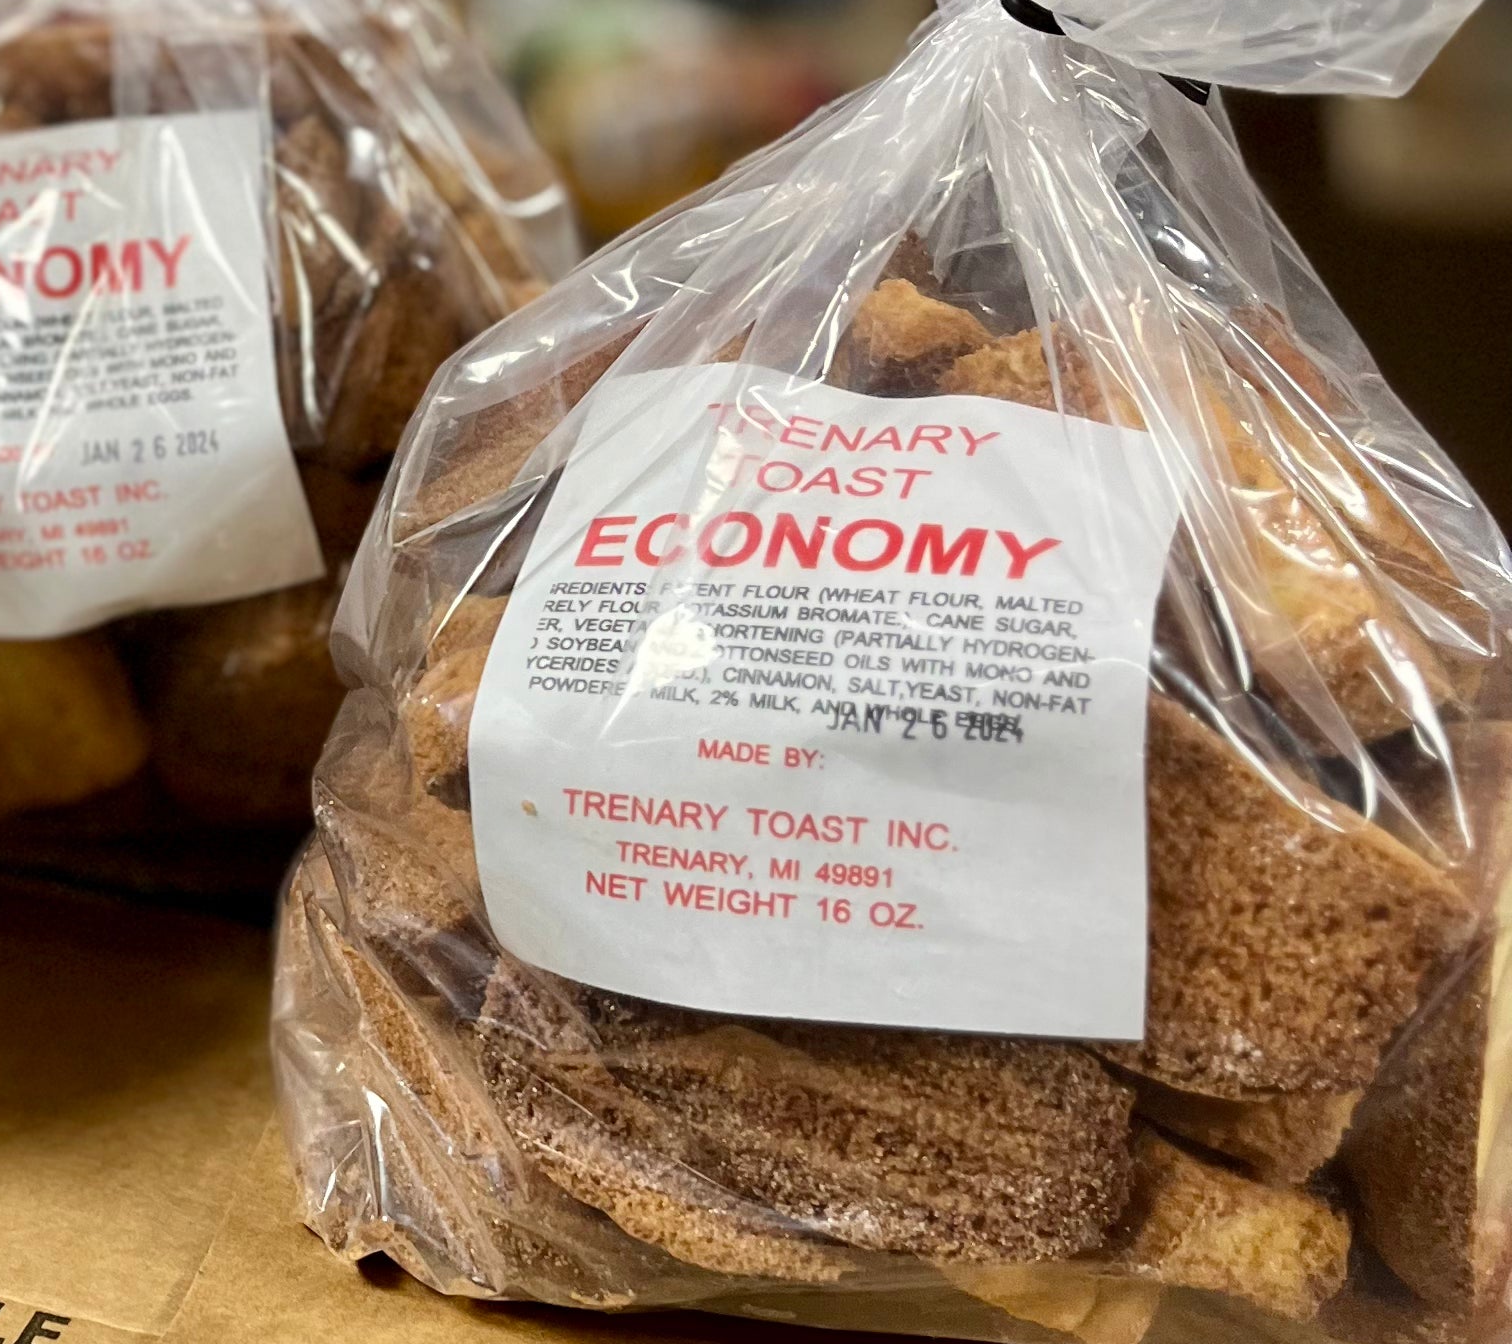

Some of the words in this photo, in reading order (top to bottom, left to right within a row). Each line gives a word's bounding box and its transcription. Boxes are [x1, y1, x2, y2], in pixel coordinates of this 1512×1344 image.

[171, 364, 239, 383] NON-FAT
[204, 348, 238, 362] AND
[81, 439, 121, 466] JAN
[175, 430, 220, 457] 2024
[707, 403, 1000, 457] TRENARY
[20, 485, 101, 513] TOAST
[115, 480, 167, 504] INC.
[725, 453, 932, 500] TOAST
[573, 512, 1063, 580] ECONOMY
[543, 600, 592, 613] RELY
[598, 600, 660, 614] FLOUR
[691, 602, 788, 620] OTASSIUM
[926, 612, 985, 630] CANE
[995, 617, 1077, 640] SUGAR,
[742, 584, 809, 601] FLOUR
[818, 586, 900, 605] (WHEAT
[909, 591, 984, 610] FLOUR,
[995, 596, 1083, 615] MALTED
[546, 636, 636, 653] SOYBEAN
[710, 644, 834, 667] OTTONSEED
[844, 653, 891, 672] OILS
[902, 657, 954, 677] WITH
[966, 661, 1032, 684] MONO
[1043, 670, 1091, 690] AND
[574, 618, 648, 633] VEGETA
[700, 623, 824, 645] HORTENING
[834, 629, 954, 654] (PARTIALLY
[962, 638, 1095, 664] HYDROGEN-
[527, 655, 620, 673] YCERIDES
[722, 667, 836, 694] CINNAMON,
[992, 689, 1092, 715] NON-FAT
[528, 676, 628, 697] POWDERE
[649, 686, 700, 704] MILK,
[710, 689, 739, 707] 2%
[750, 692, 801, 713] MILK,
[697, 738, 770, 765] MADE
[783, 747, 825, 770] BY:
[562, 788, 729, 832] TRENARY
[747, 807, 868, 844] TOAST
[887, 819, 959, 852] INC.
[616, 840, 754, 880] TRENARY,
[769, 858, 800, 881] MI
[814, 862, 894, 889] 49891
[585, 870, 648, 901] NET
[664, 880, 797, 919] WEIGHT
[817, 898, 851, 924] 16
[869, 902, 925, 929] OZ.
